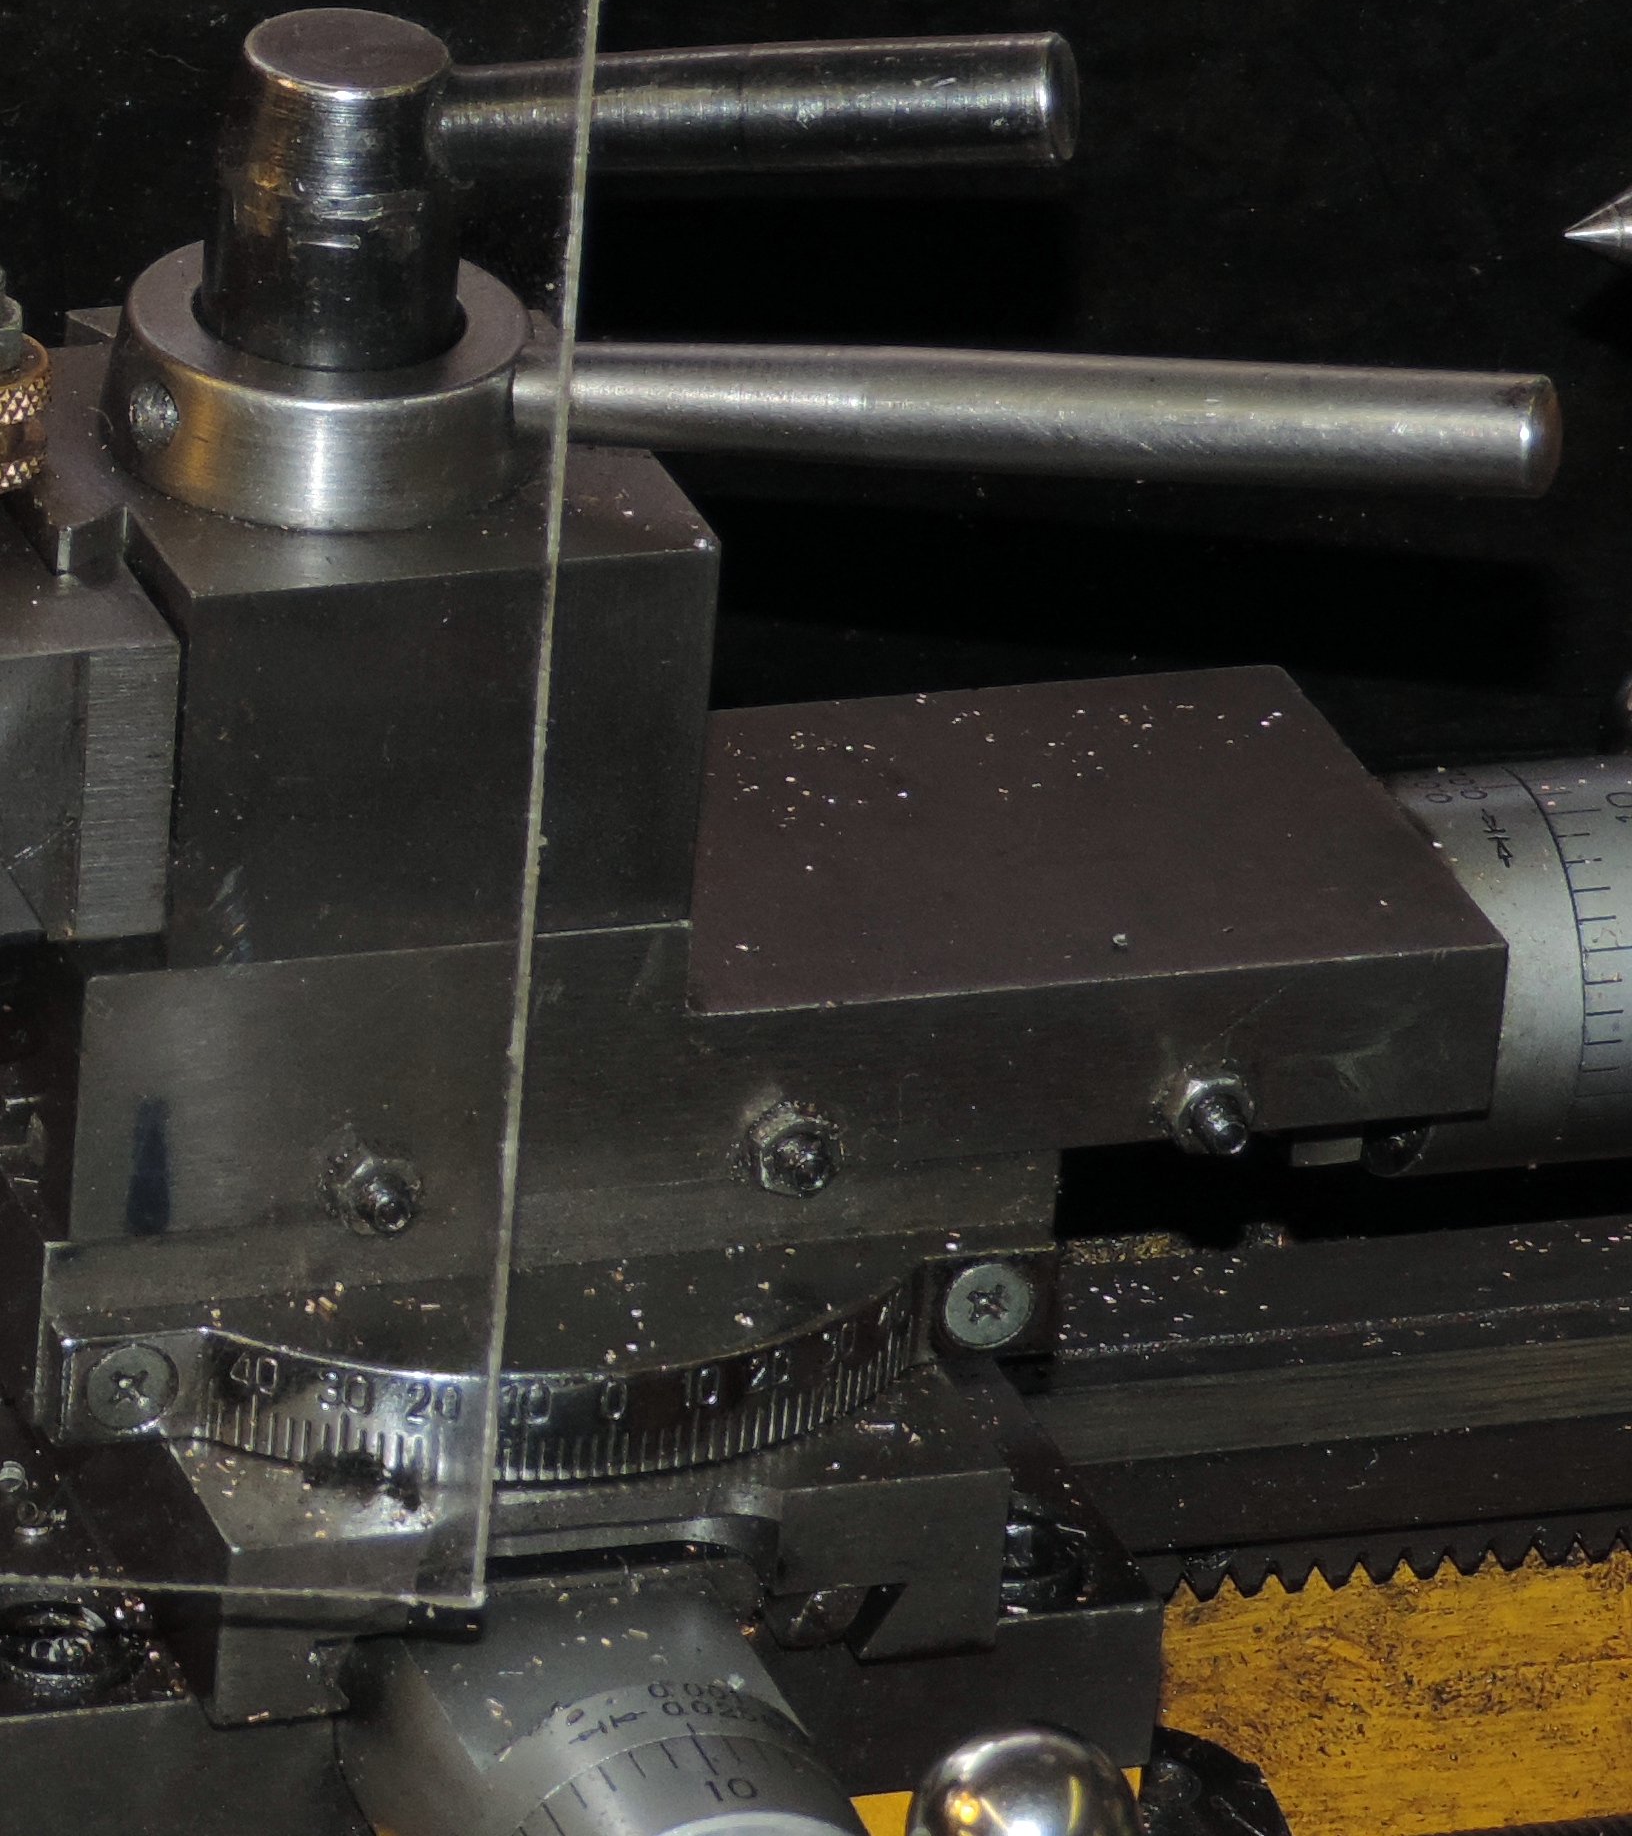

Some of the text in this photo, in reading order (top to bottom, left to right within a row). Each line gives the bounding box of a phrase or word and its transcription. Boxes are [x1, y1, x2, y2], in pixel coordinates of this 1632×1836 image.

[229, 1352, 279, 1396] 40
[317, 1370, 374, 1416] 30
[405, 1380, 462, 1425] 20
[601, 1378, 628, 1421] 0
[683, 1362, 720, 1410] 10
[704, 1777, 759, 1803] 10
